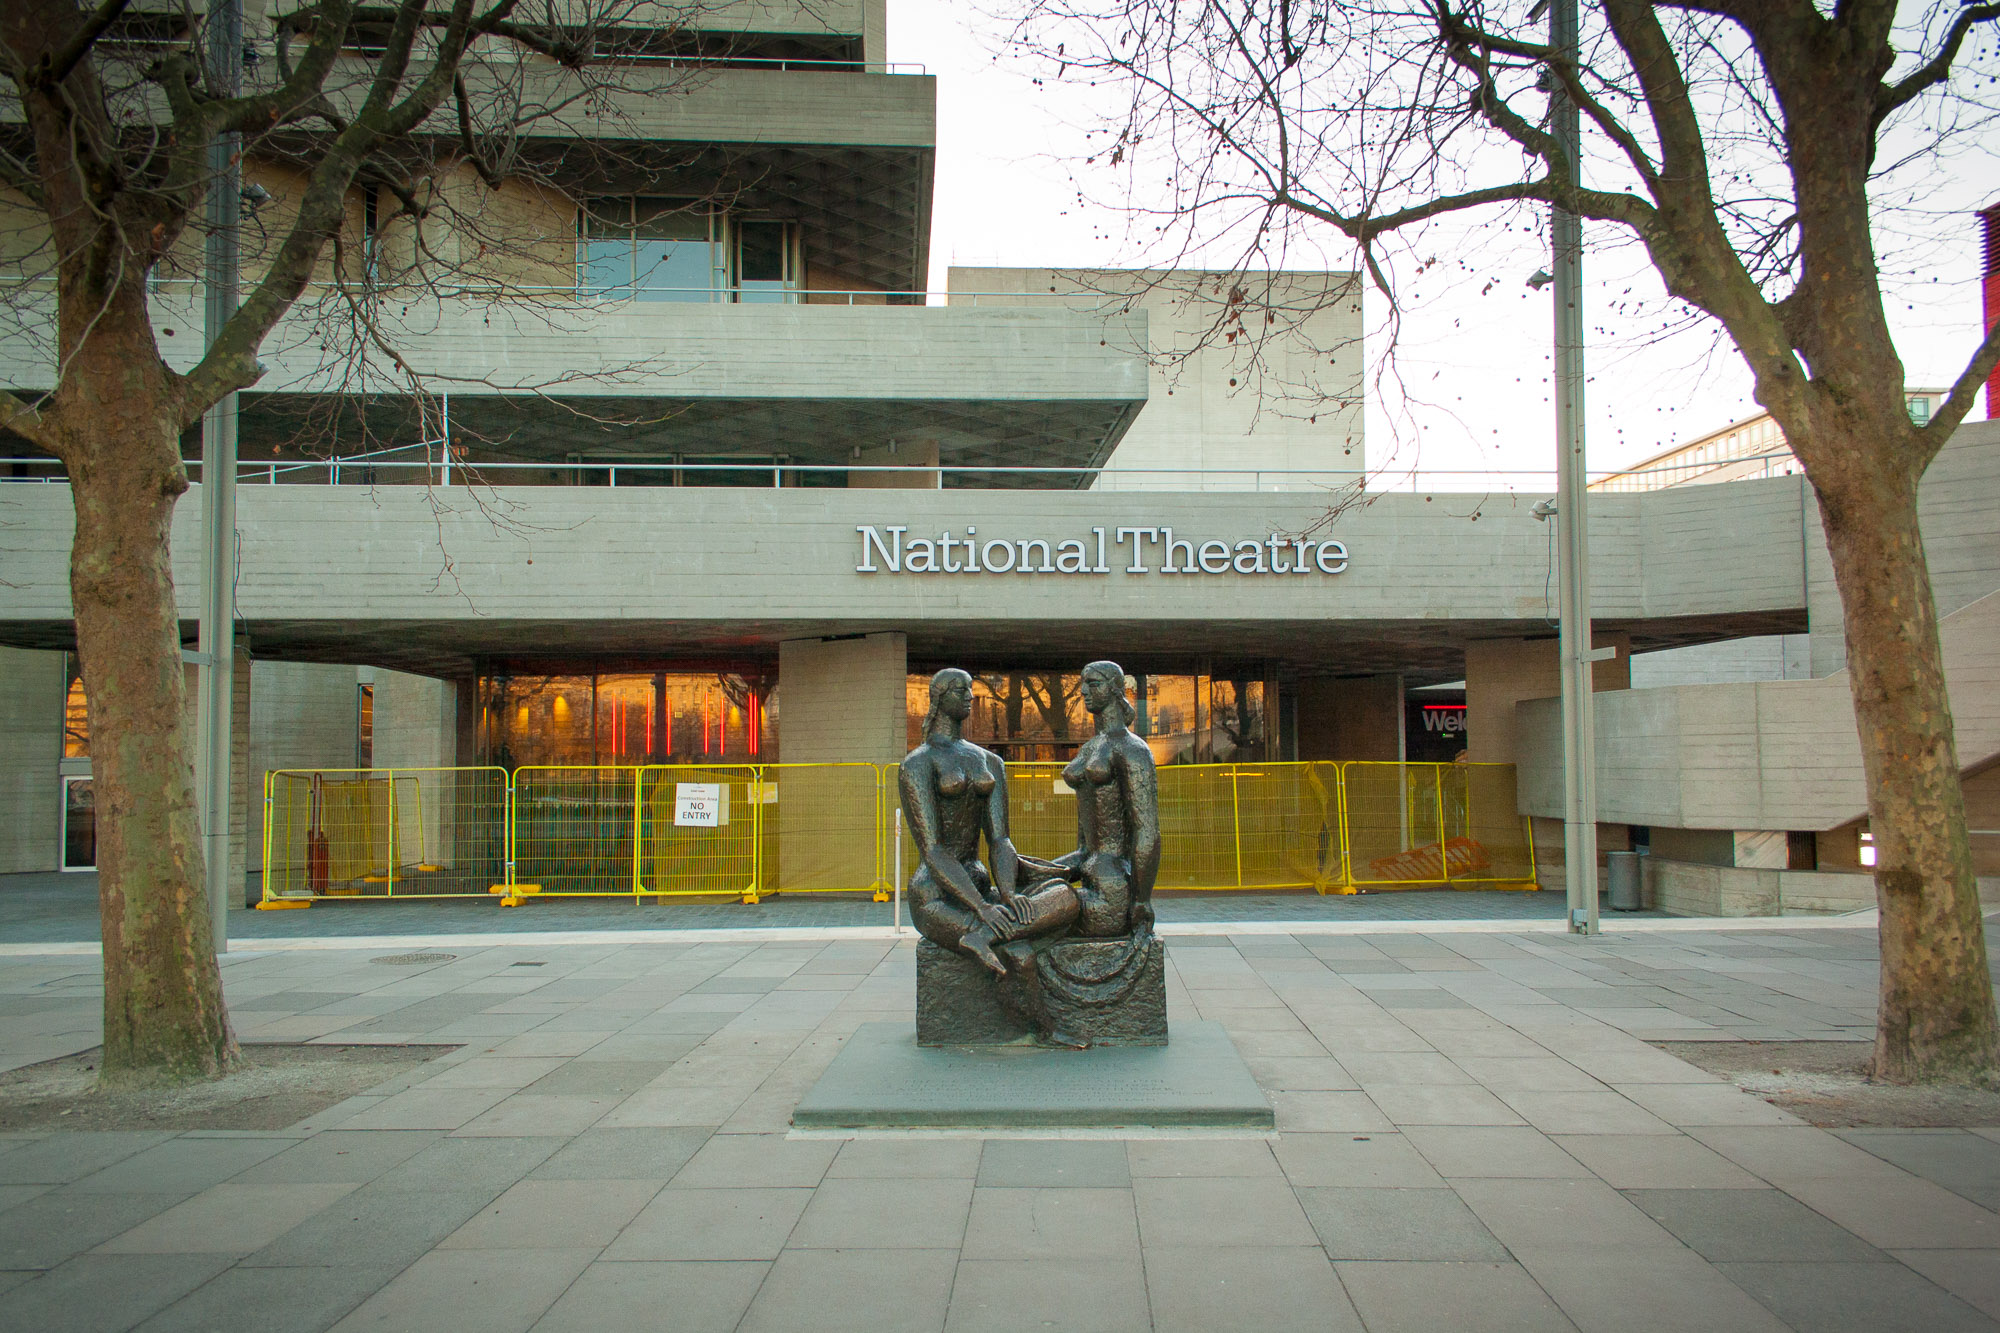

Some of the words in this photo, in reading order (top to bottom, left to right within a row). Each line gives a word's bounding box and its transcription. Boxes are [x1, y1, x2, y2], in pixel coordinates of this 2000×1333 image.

[856, 525, 1110, 573] National
[1116, 527, 1349, 574] Theatre
[690, 802, 704, 810] NO
[682, 811, 711, 819] ENTRY
